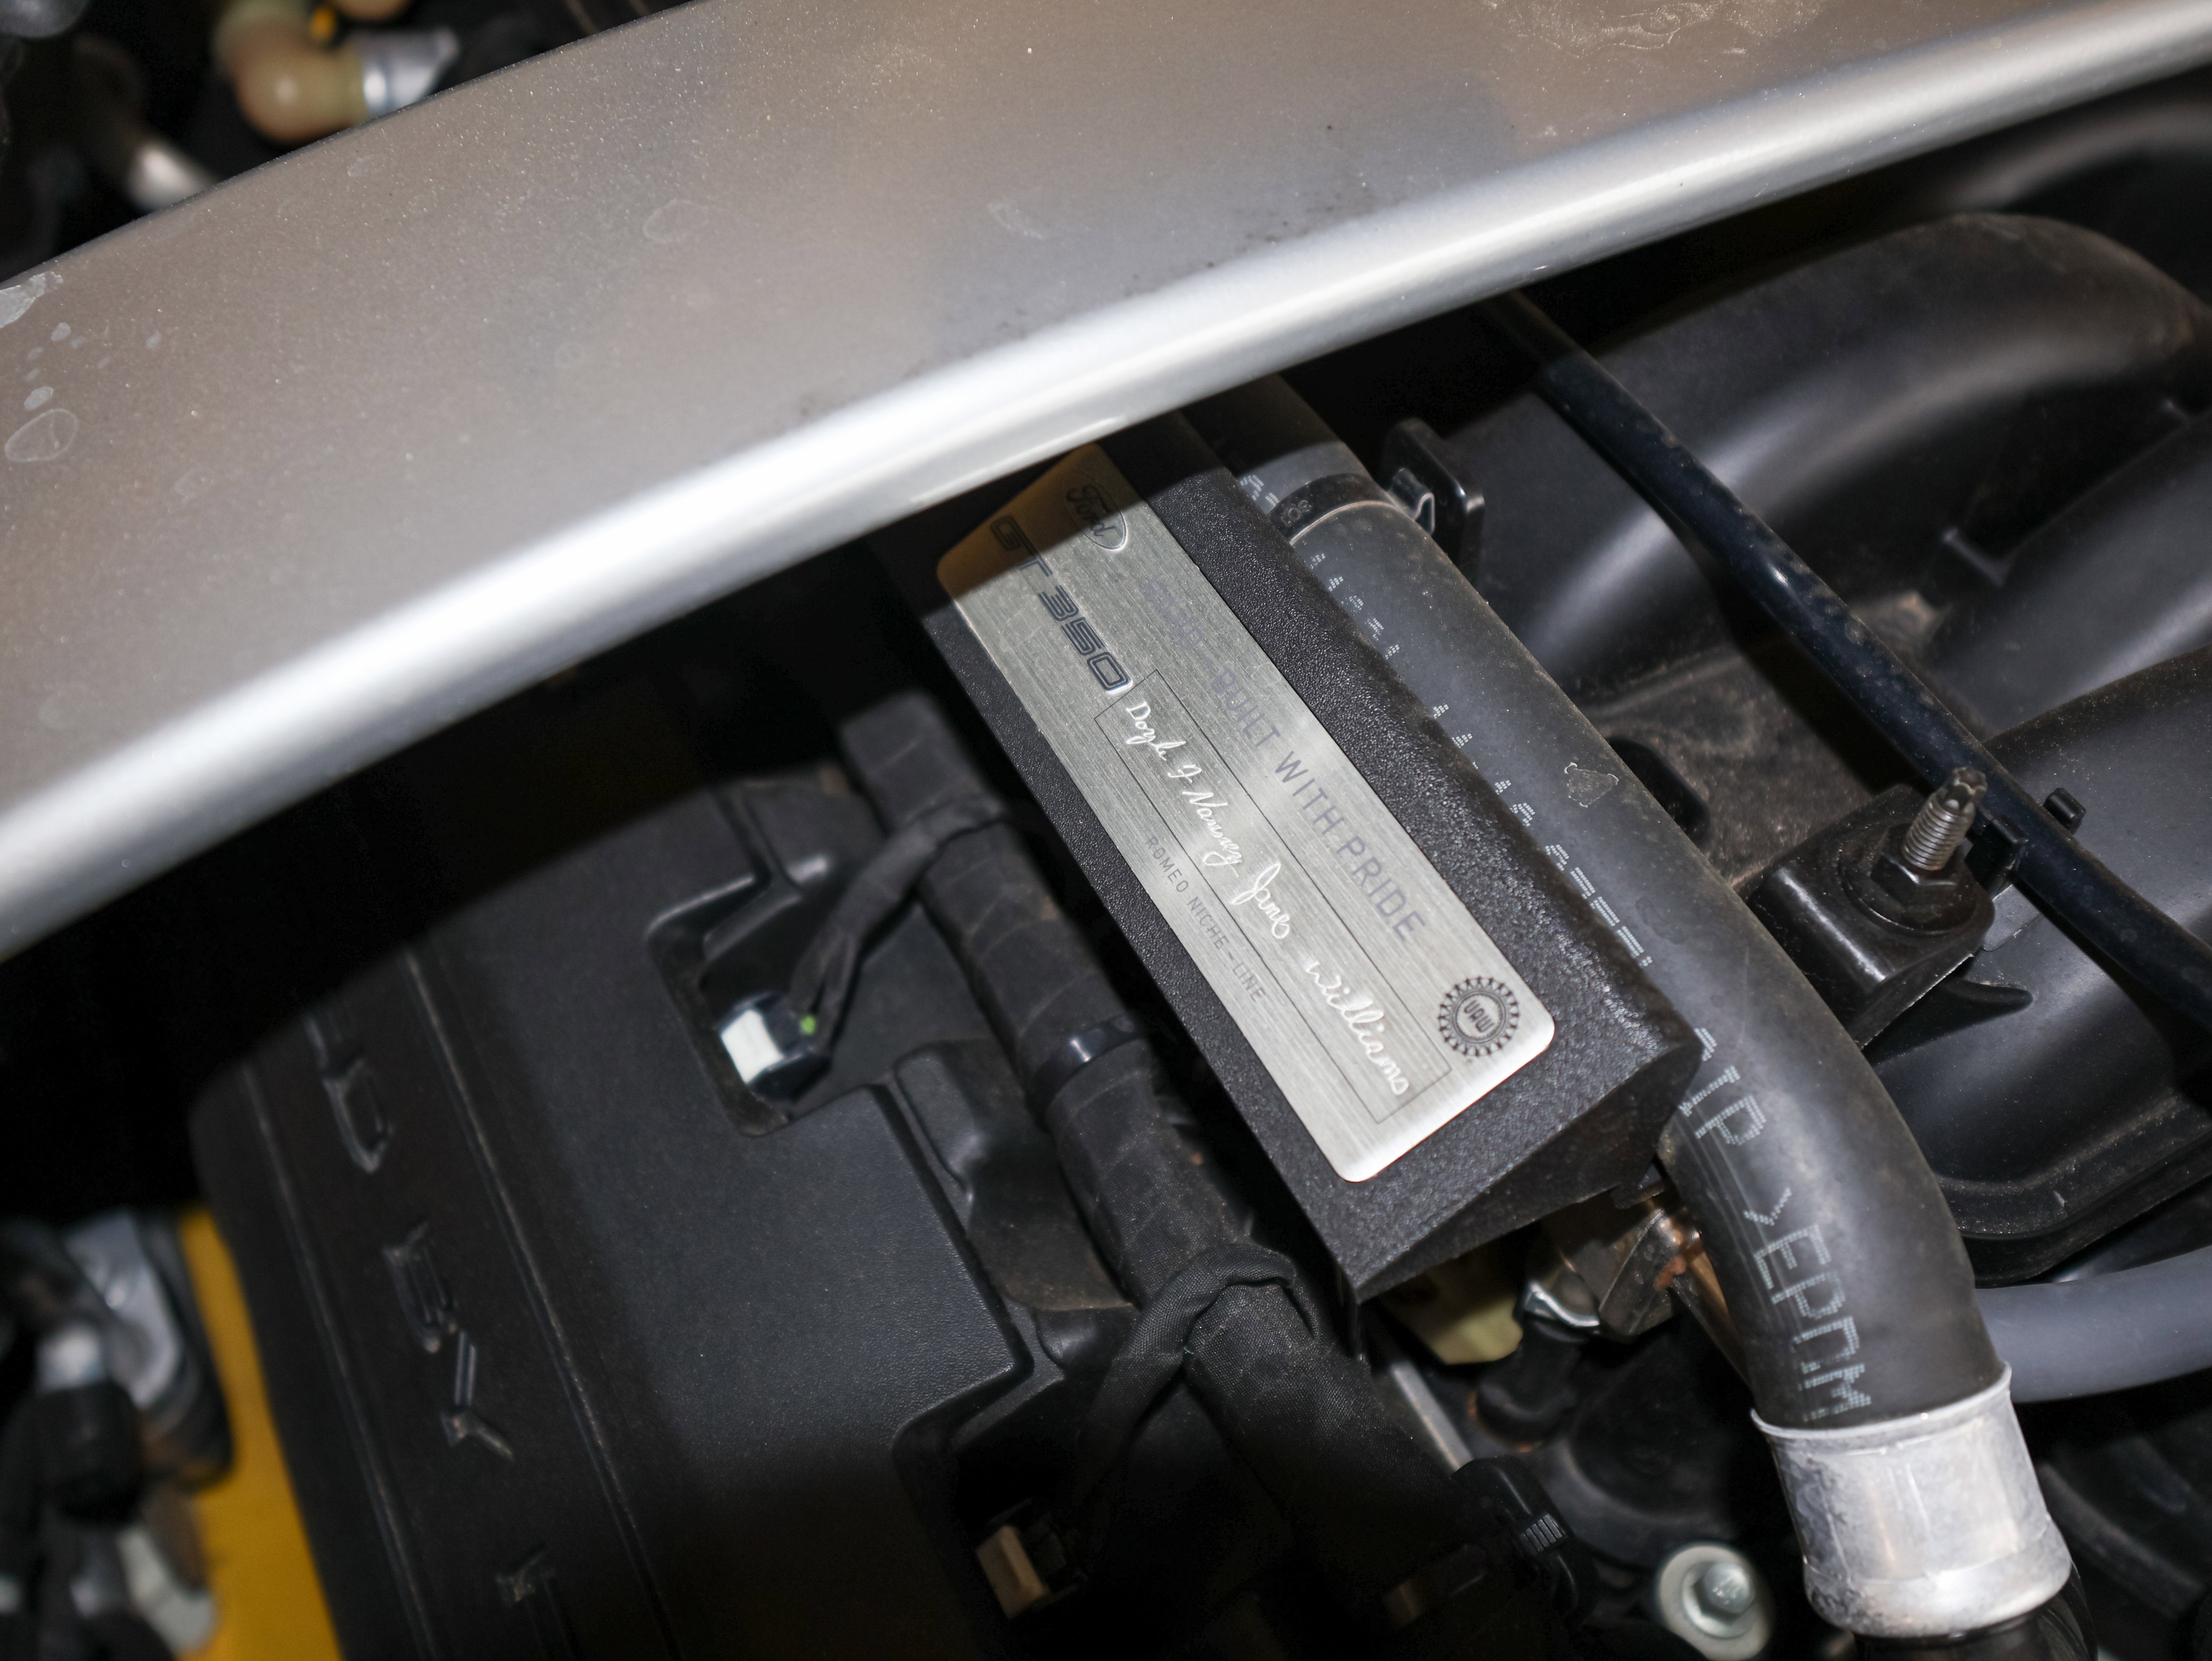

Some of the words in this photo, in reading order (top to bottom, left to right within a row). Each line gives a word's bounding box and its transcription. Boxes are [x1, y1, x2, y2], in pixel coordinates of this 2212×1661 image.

[1066, 484, 1116, 537] Ford
[1145, 836, 1189, 892] ROMEO
[1275, 750, 1345, 836] WITH
[1336, 835, 1426, 942] PRIDE
[1463, 999, 1495, 1033] UAW
